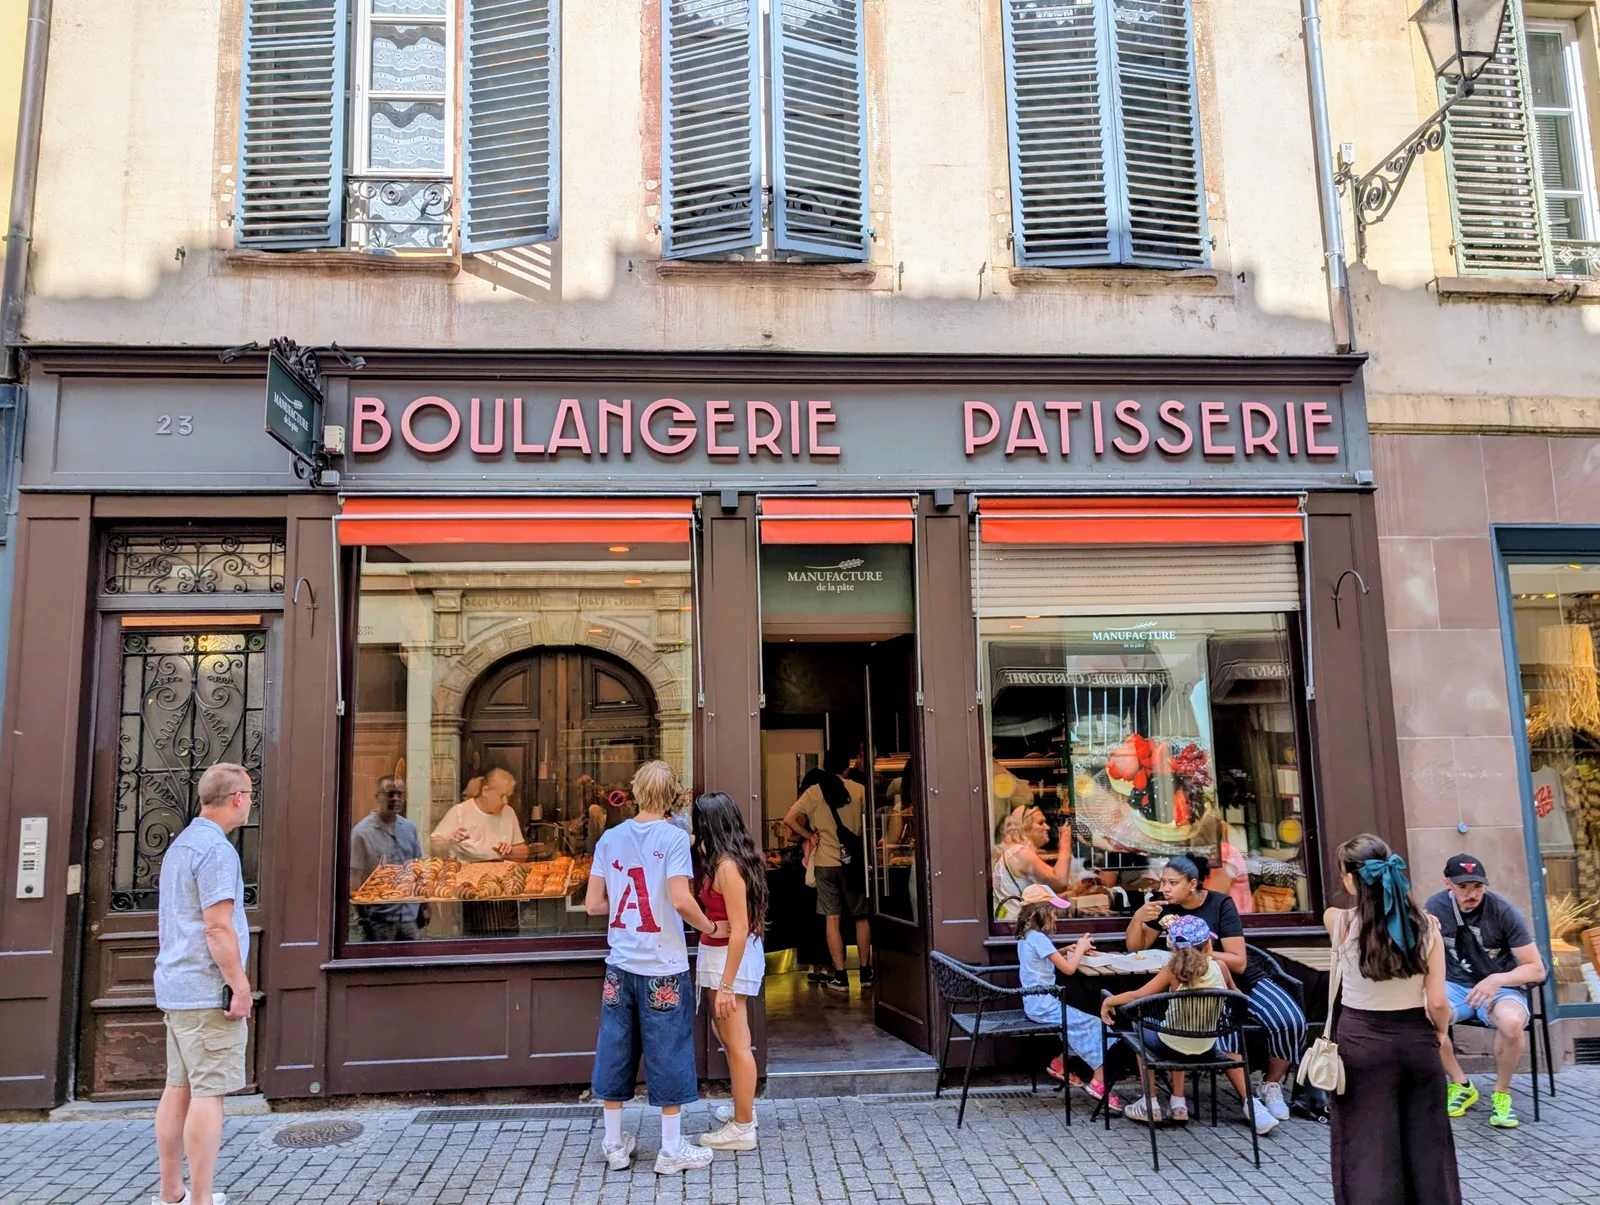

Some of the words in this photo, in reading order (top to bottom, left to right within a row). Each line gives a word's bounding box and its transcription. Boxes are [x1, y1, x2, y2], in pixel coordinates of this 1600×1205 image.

[156, 414, 194, 436] 23
[273, 391, 309, 432] MANUFACTURE
[353, 396, 841, 456] BOULANGERIE
[964, 400, 1339, 455] PATISSERIE
[787, 571, 883, 581] MANUFACTURE
[816, 583, 826, 591] de
[828, 583, 835, 591] la
[837, 583, 854, 593] pâte
[1092, 631, 1176, 640] MANUFACTURE
[610, 867, 661, 932] A
